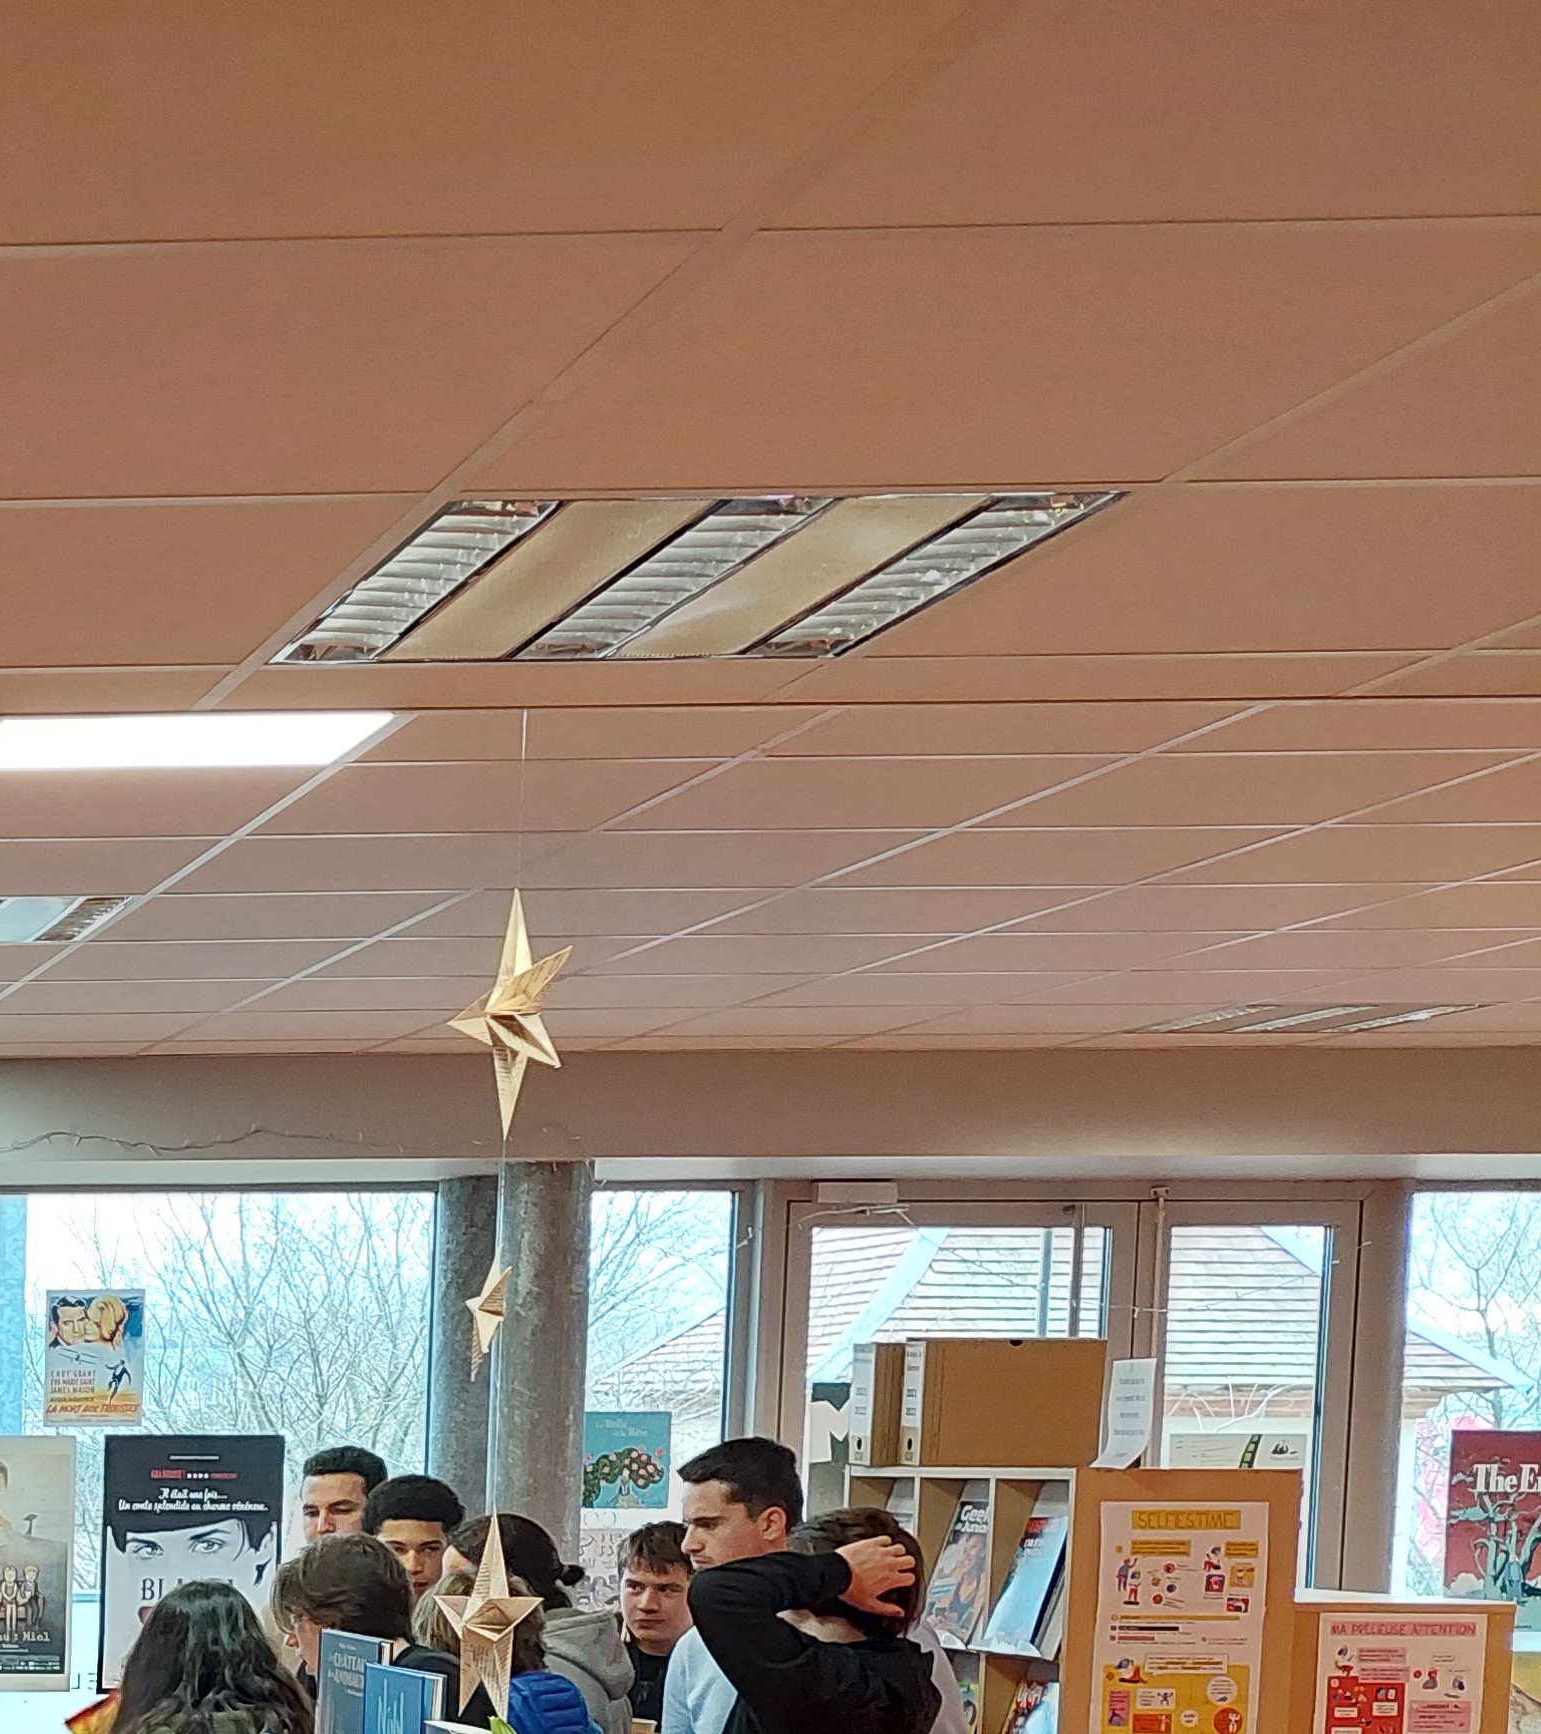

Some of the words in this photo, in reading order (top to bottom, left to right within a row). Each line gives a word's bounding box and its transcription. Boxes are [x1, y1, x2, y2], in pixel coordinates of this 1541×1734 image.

[1473, 1463, 1517, 1493] The
[1518, 1463, 1541, 1493] E
[22, 1631, 51, 1641] Miel
